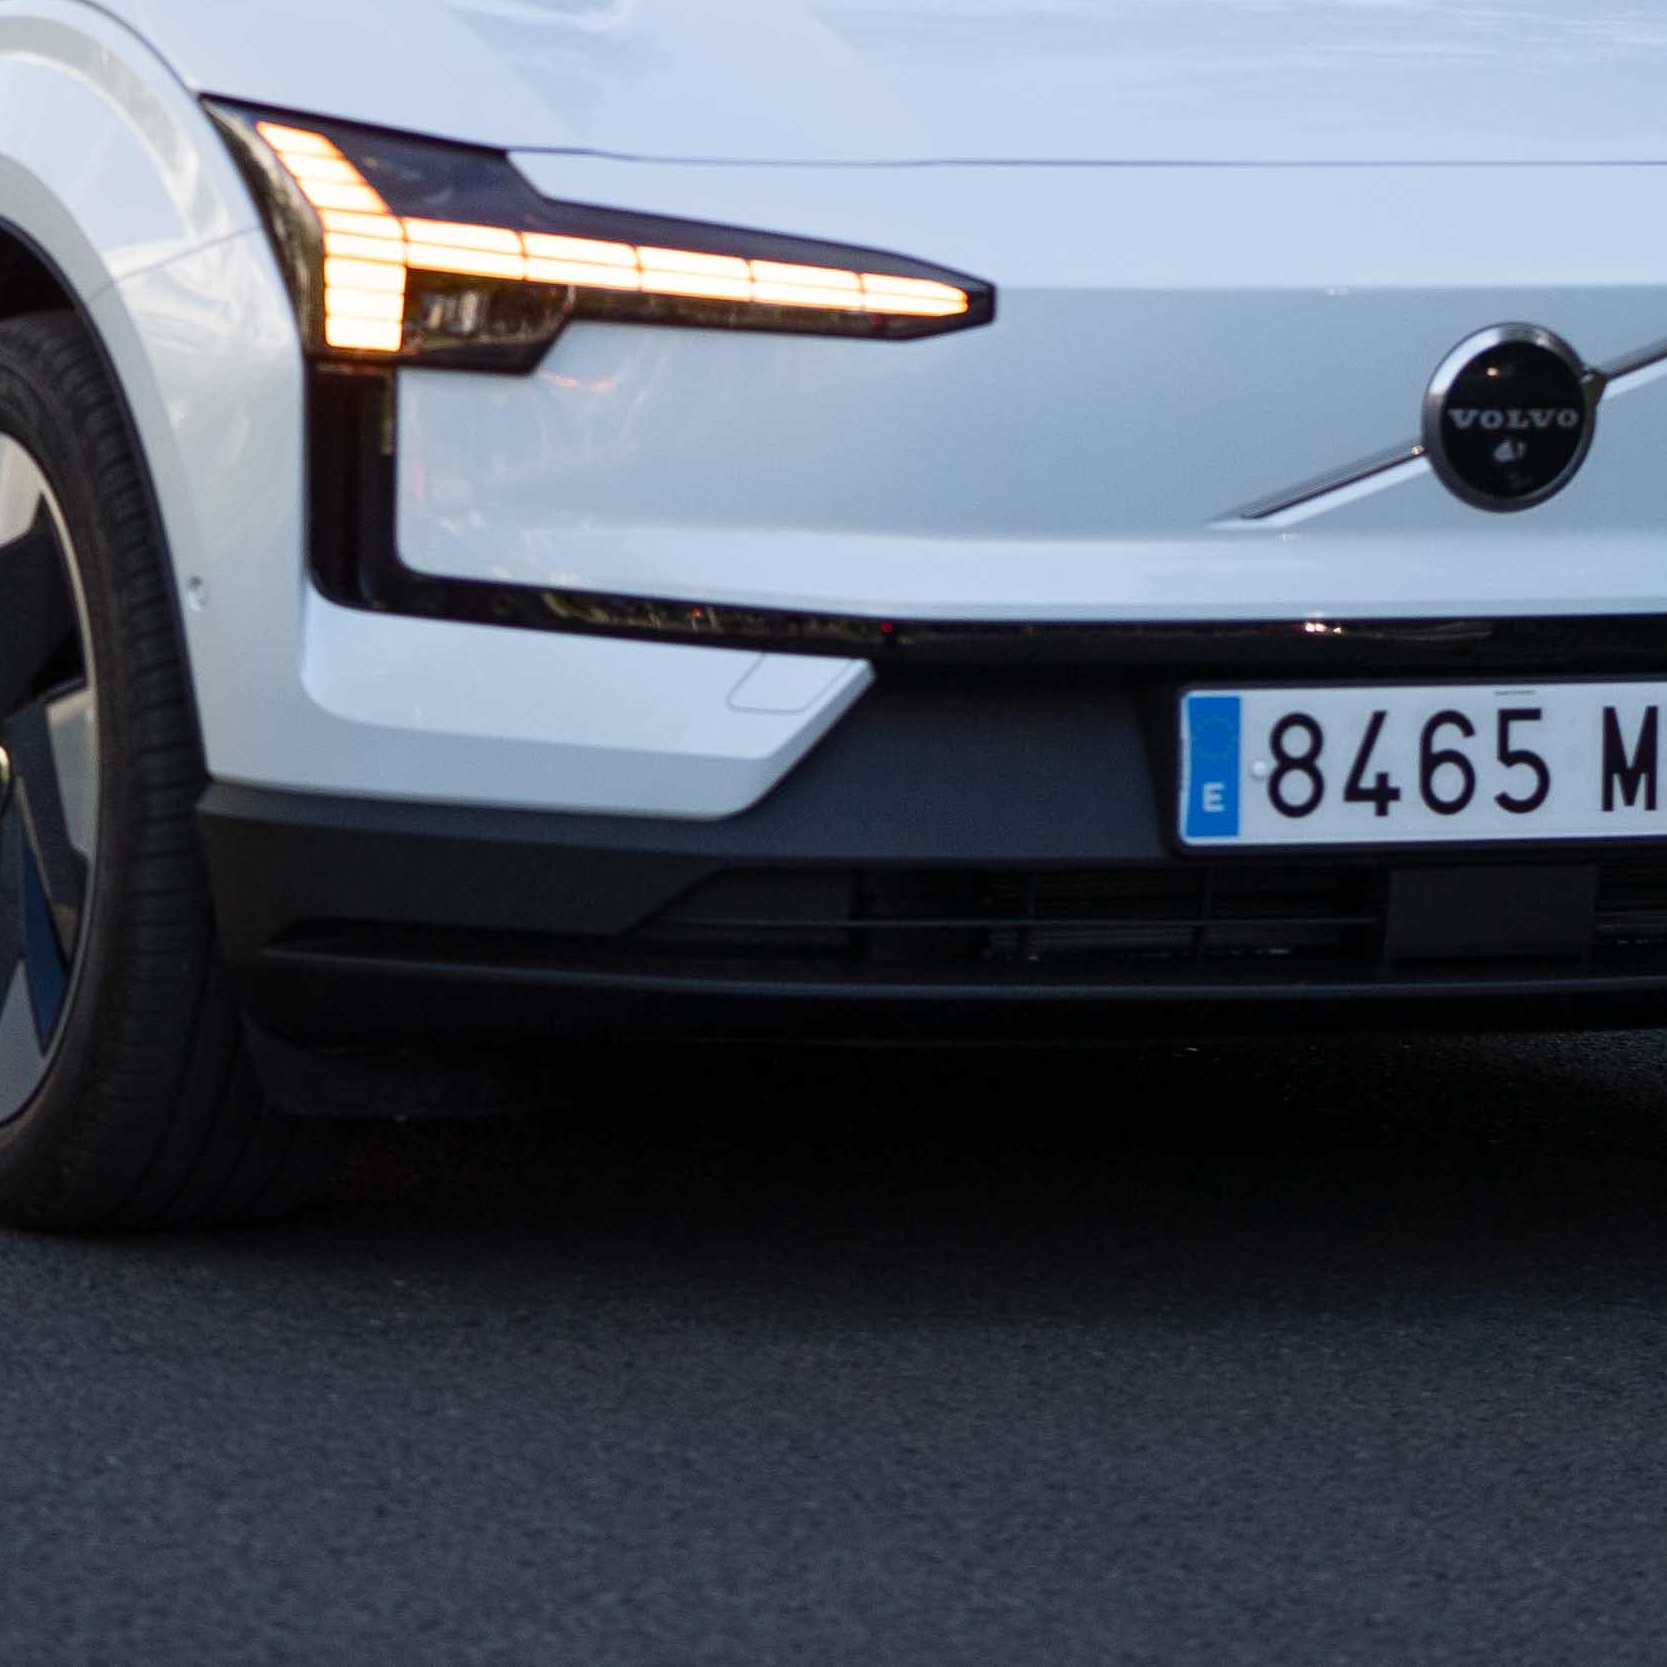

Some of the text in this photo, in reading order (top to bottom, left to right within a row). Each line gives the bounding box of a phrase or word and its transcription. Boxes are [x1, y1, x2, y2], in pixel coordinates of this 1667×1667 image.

[1448, 408, 1580, 430] VOLVO
[1266, 707, 1551, 820] 8465
[1202, 782, 1226, 813] E
